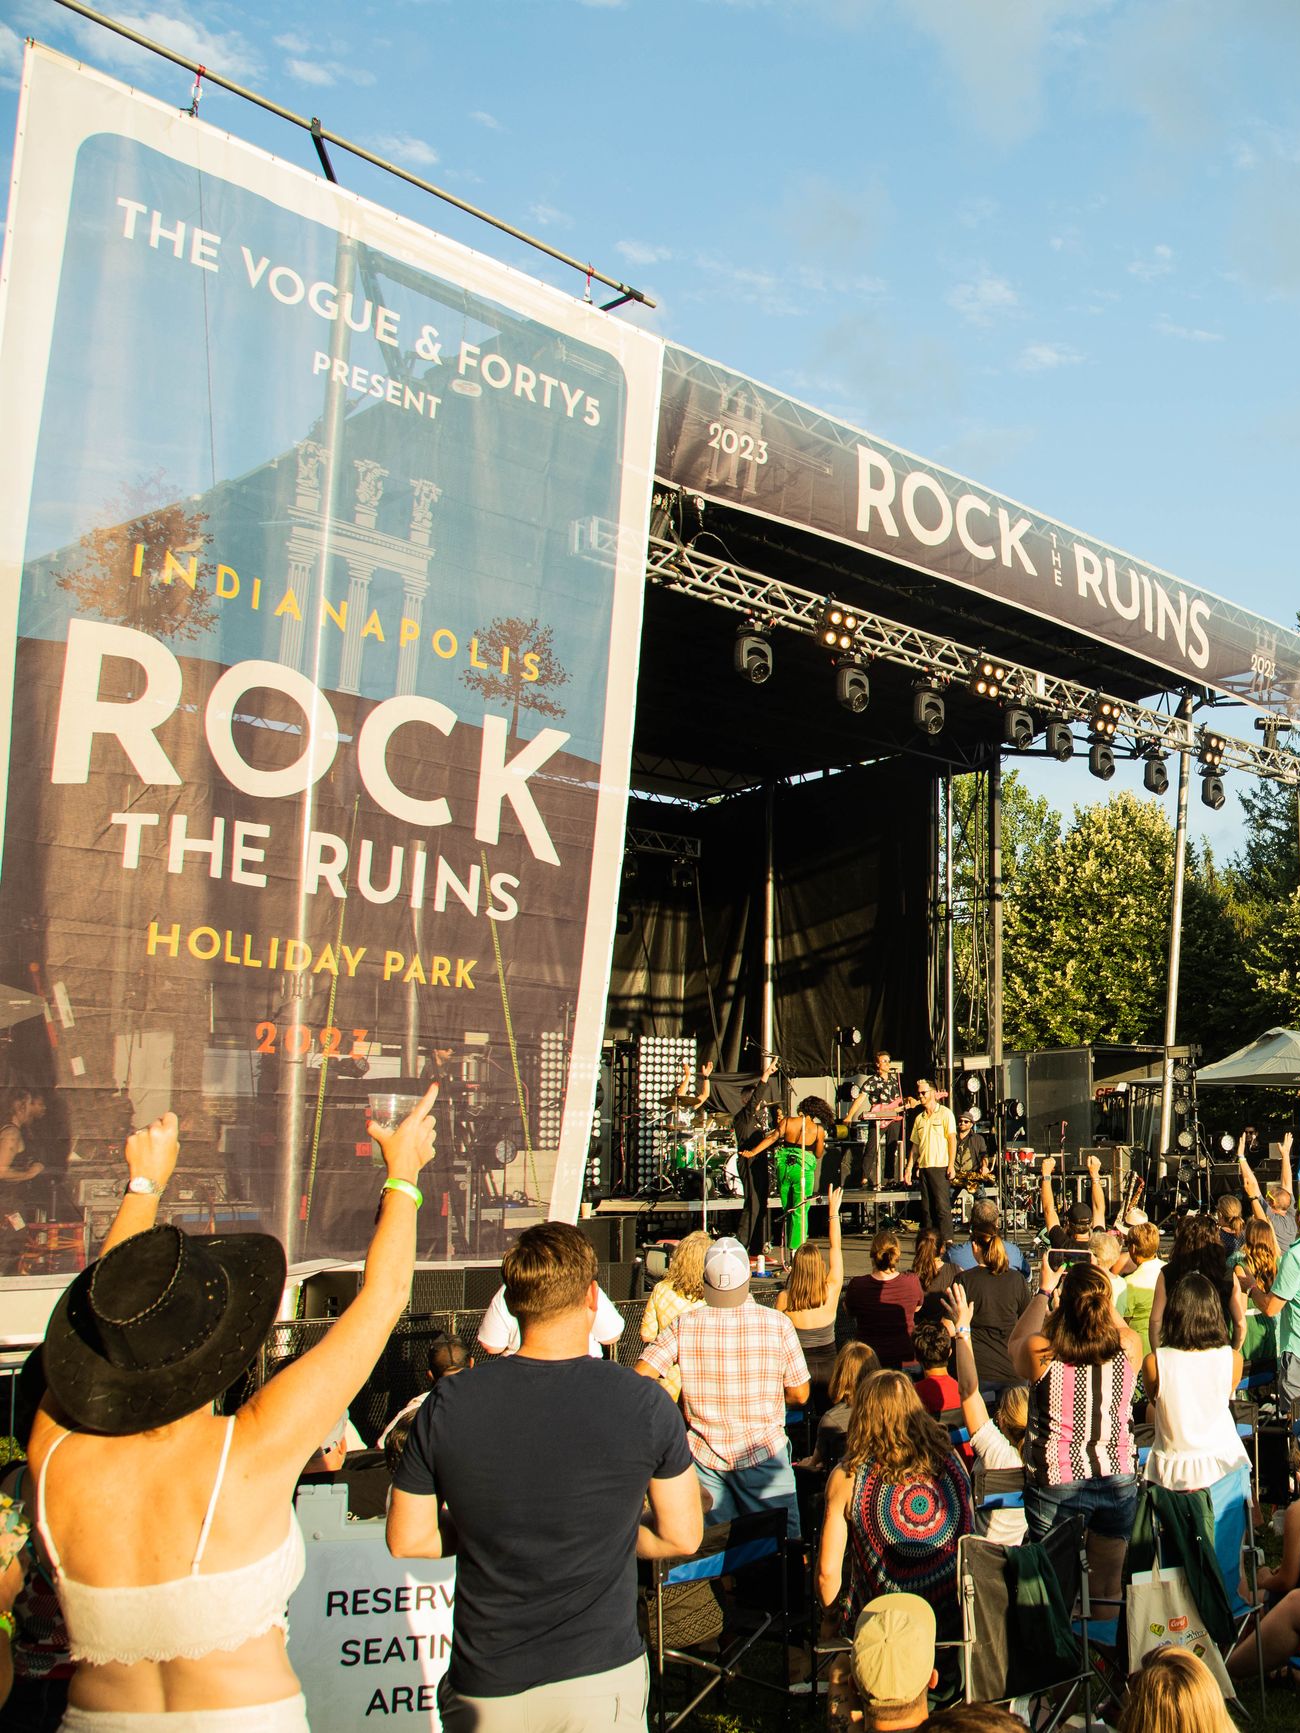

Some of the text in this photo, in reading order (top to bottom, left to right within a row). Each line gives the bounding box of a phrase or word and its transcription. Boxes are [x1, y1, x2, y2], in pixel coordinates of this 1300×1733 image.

[116, 196, 602, 427] THE VOGUE & FORTY5
[312, 350, 442, 420] PRESENT
[707, 421, 770, 465] 2023
[855, 442, 1038, 577] ROCK
[1049, 532, 1063, 587] THE
[132, 543, 542, 683] INDIANAPOLIS
[1072, 541, 1213, 669] RUINS
[50, 617, 572, 868] ROCK
[110, 812, 521, 922] THE RUINS
[146, 922, 479, 989] HOLLIDAY PARK
[255, 1021, 369, 1060] 2023
[326, 1584, 456, 1617] RESERV
[340, 1633, 454, 1667] SEATIN
[365, 1684, 440, 1716] ARE
